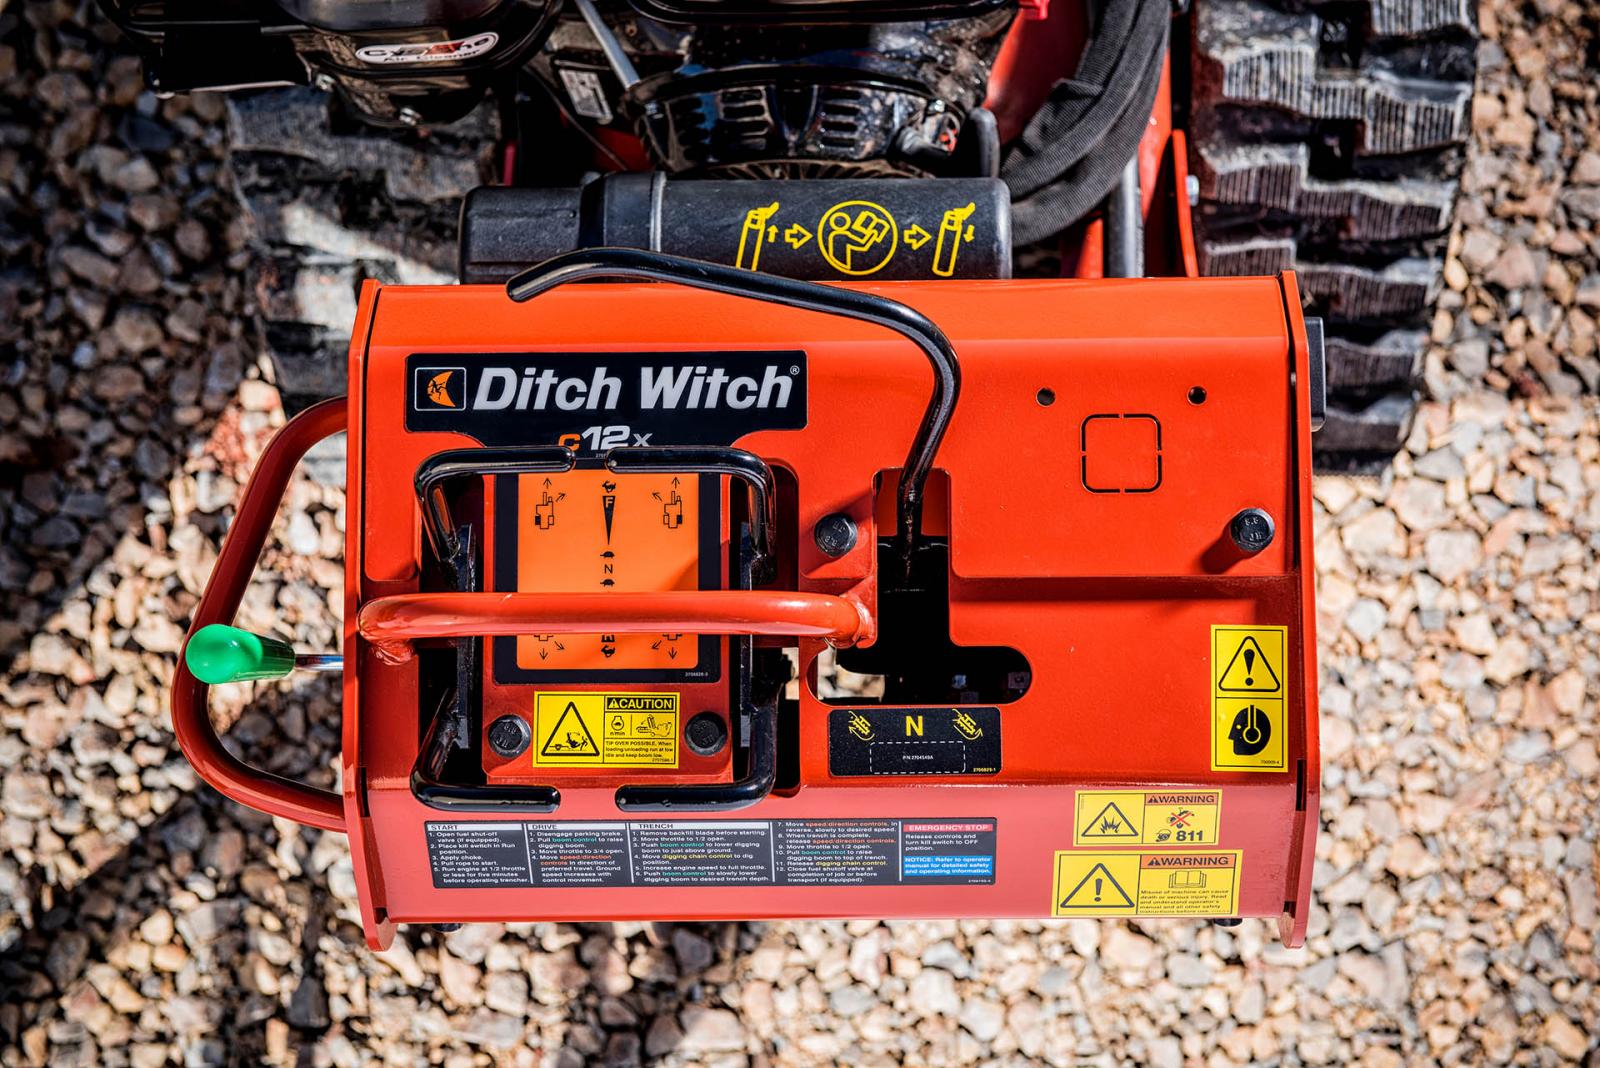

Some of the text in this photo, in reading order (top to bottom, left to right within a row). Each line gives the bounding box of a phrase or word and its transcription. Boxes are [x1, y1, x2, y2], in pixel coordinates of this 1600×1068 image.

[472, 367, 622, 410] Ditch
[605, 564, 613, 574] N
[619, 699, 672, 708] CAUTION
[906, 716, 923, 736] N
[1158, 795, 1214, 803] WARNING
[1176, 831, 1203, 841] 811
[1160, 857, 1229, 865] WARNING
